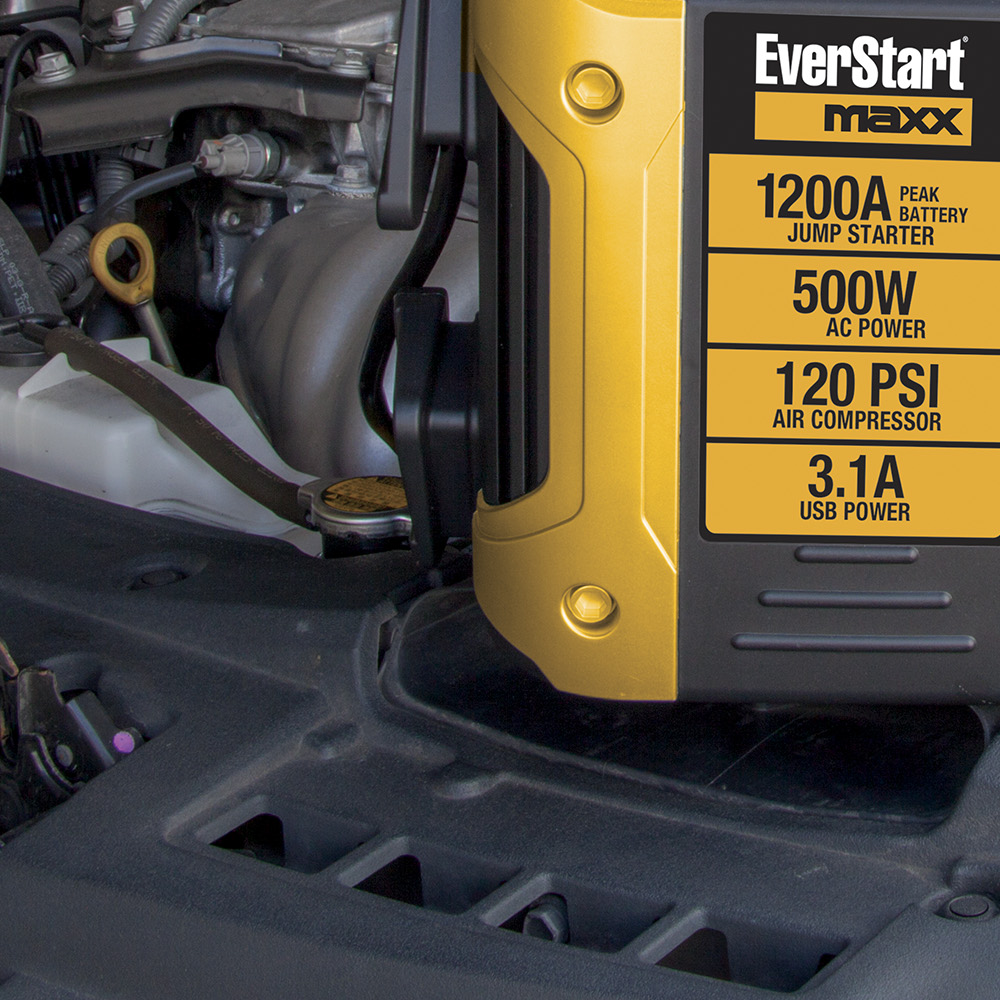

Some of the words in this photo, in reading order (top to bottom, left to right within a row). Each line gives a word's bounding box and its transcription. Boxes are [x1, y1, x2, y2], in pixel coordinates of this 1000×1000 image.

[756, 33, 964, 90] EverStart
[824, 104, 963, 135] maxx
[758, 173, 892, 221] 1200A
[900, 186, 940, 202] PEAK
[899, 206, 969, 224] BATTERY
[788, 223, 842, 242] JUMP
[848, 224, 934, 245] STARTER
[793, 270, 917, 315] 500W
[826, 318, 852, 337] AC
[858, 318, 926, 339] POWER
[777, 362, 855, 406] 120
[871, 363, 939, 408] PSI
[773, 409, 805, 429] AIR
[812, 410, 942, 431] COMPRESSOR
[808, 454, 904, 498] 3.1A
[800, 501, 837, 520] USB
[844, 502, 910, 521] POWER
